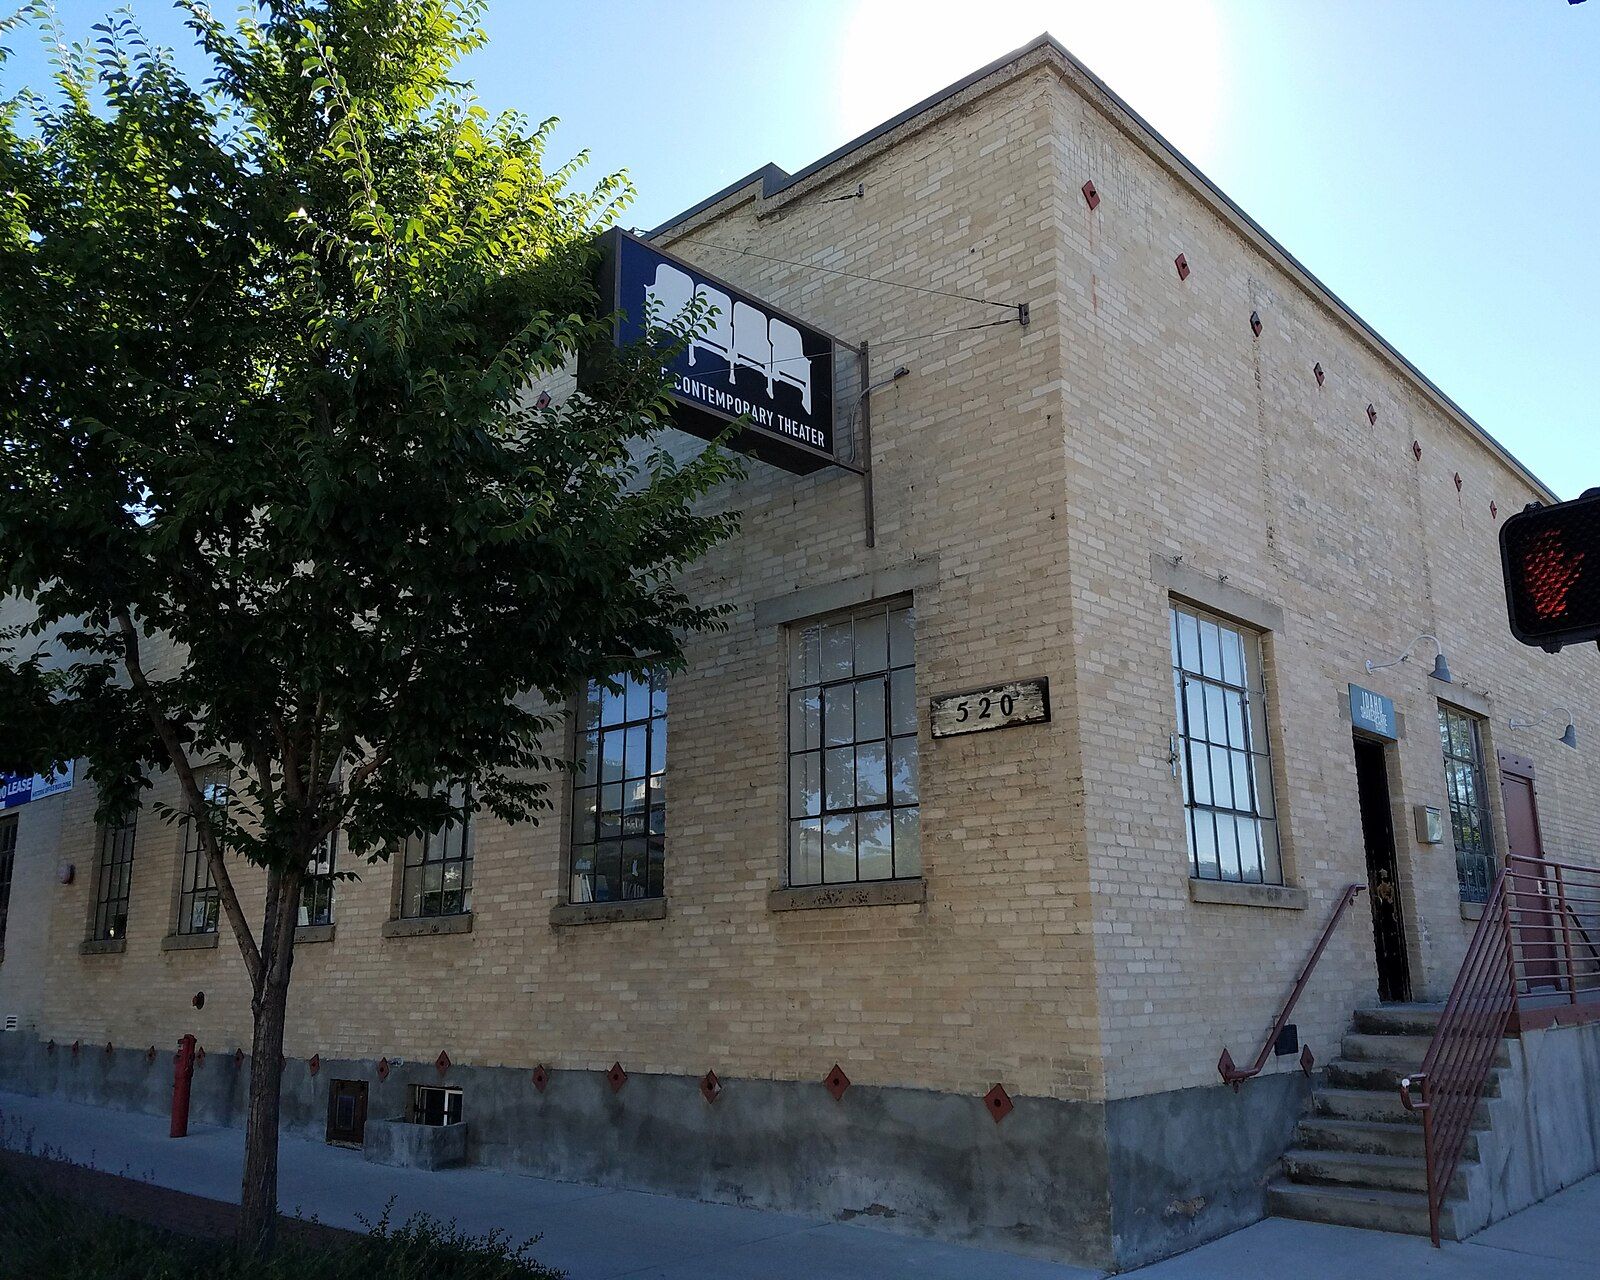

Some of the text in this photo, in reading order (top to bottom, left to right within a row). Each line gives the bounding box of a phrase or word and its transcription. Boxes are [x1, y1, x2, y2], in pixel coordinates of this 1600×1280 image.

[674, 372, 825, 448] CONTEMPORARY THEATER
[955, 694, 1014, 723] 520
[1361, 691, 1383, 714] IDAHO
[7, 778, 32, 795] LEASE
